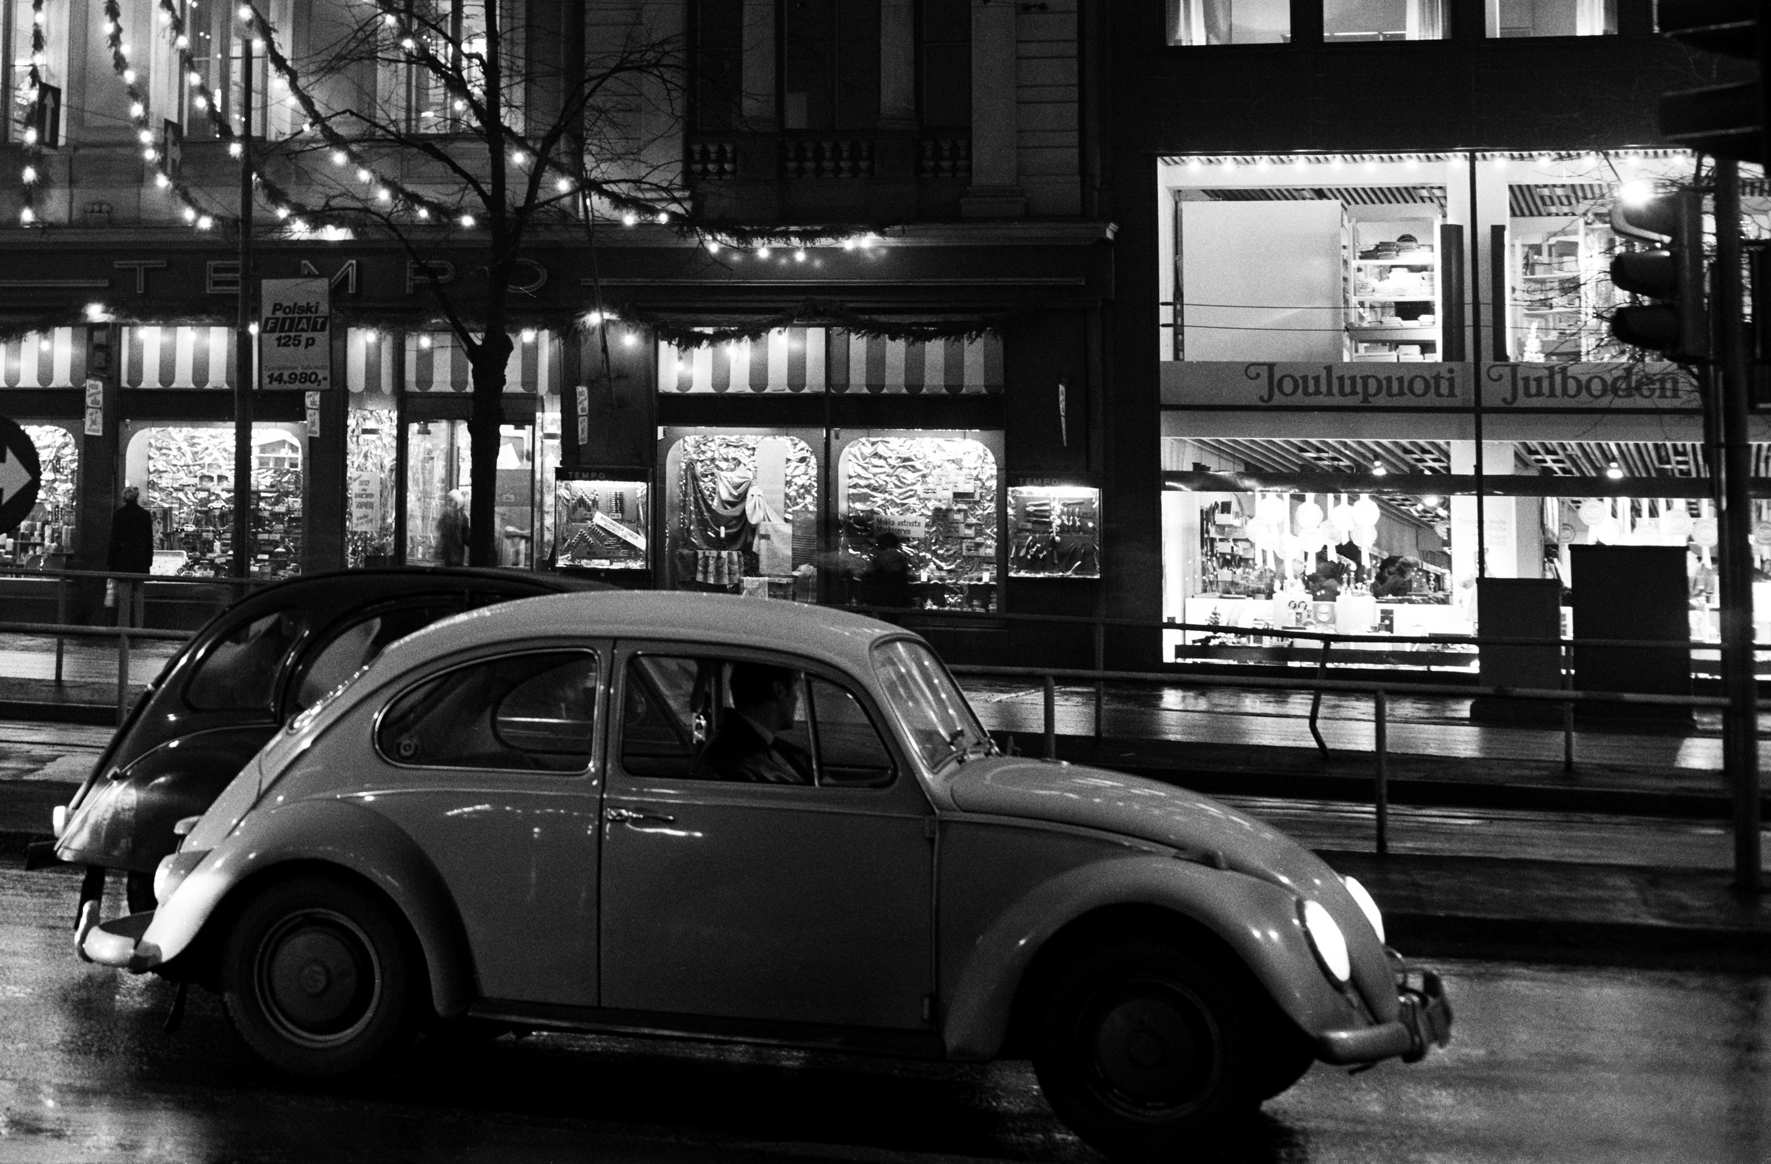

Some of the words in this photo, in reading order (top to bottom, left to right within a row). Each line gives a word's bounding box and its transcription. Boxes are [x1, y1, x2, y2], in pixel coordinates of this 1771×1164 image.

[271, 302, 320, 316] Polski
[263, 316, 328, 334] FIAT
[275, 334, 302, 348] 125
[267, 371, 328, 386] 14.980,-
[1244, 362, 1458, 404] Joulupuoti
[1486, 362, 1683, 405] Julboden
[568, 471, 606, 479] TEMPO
